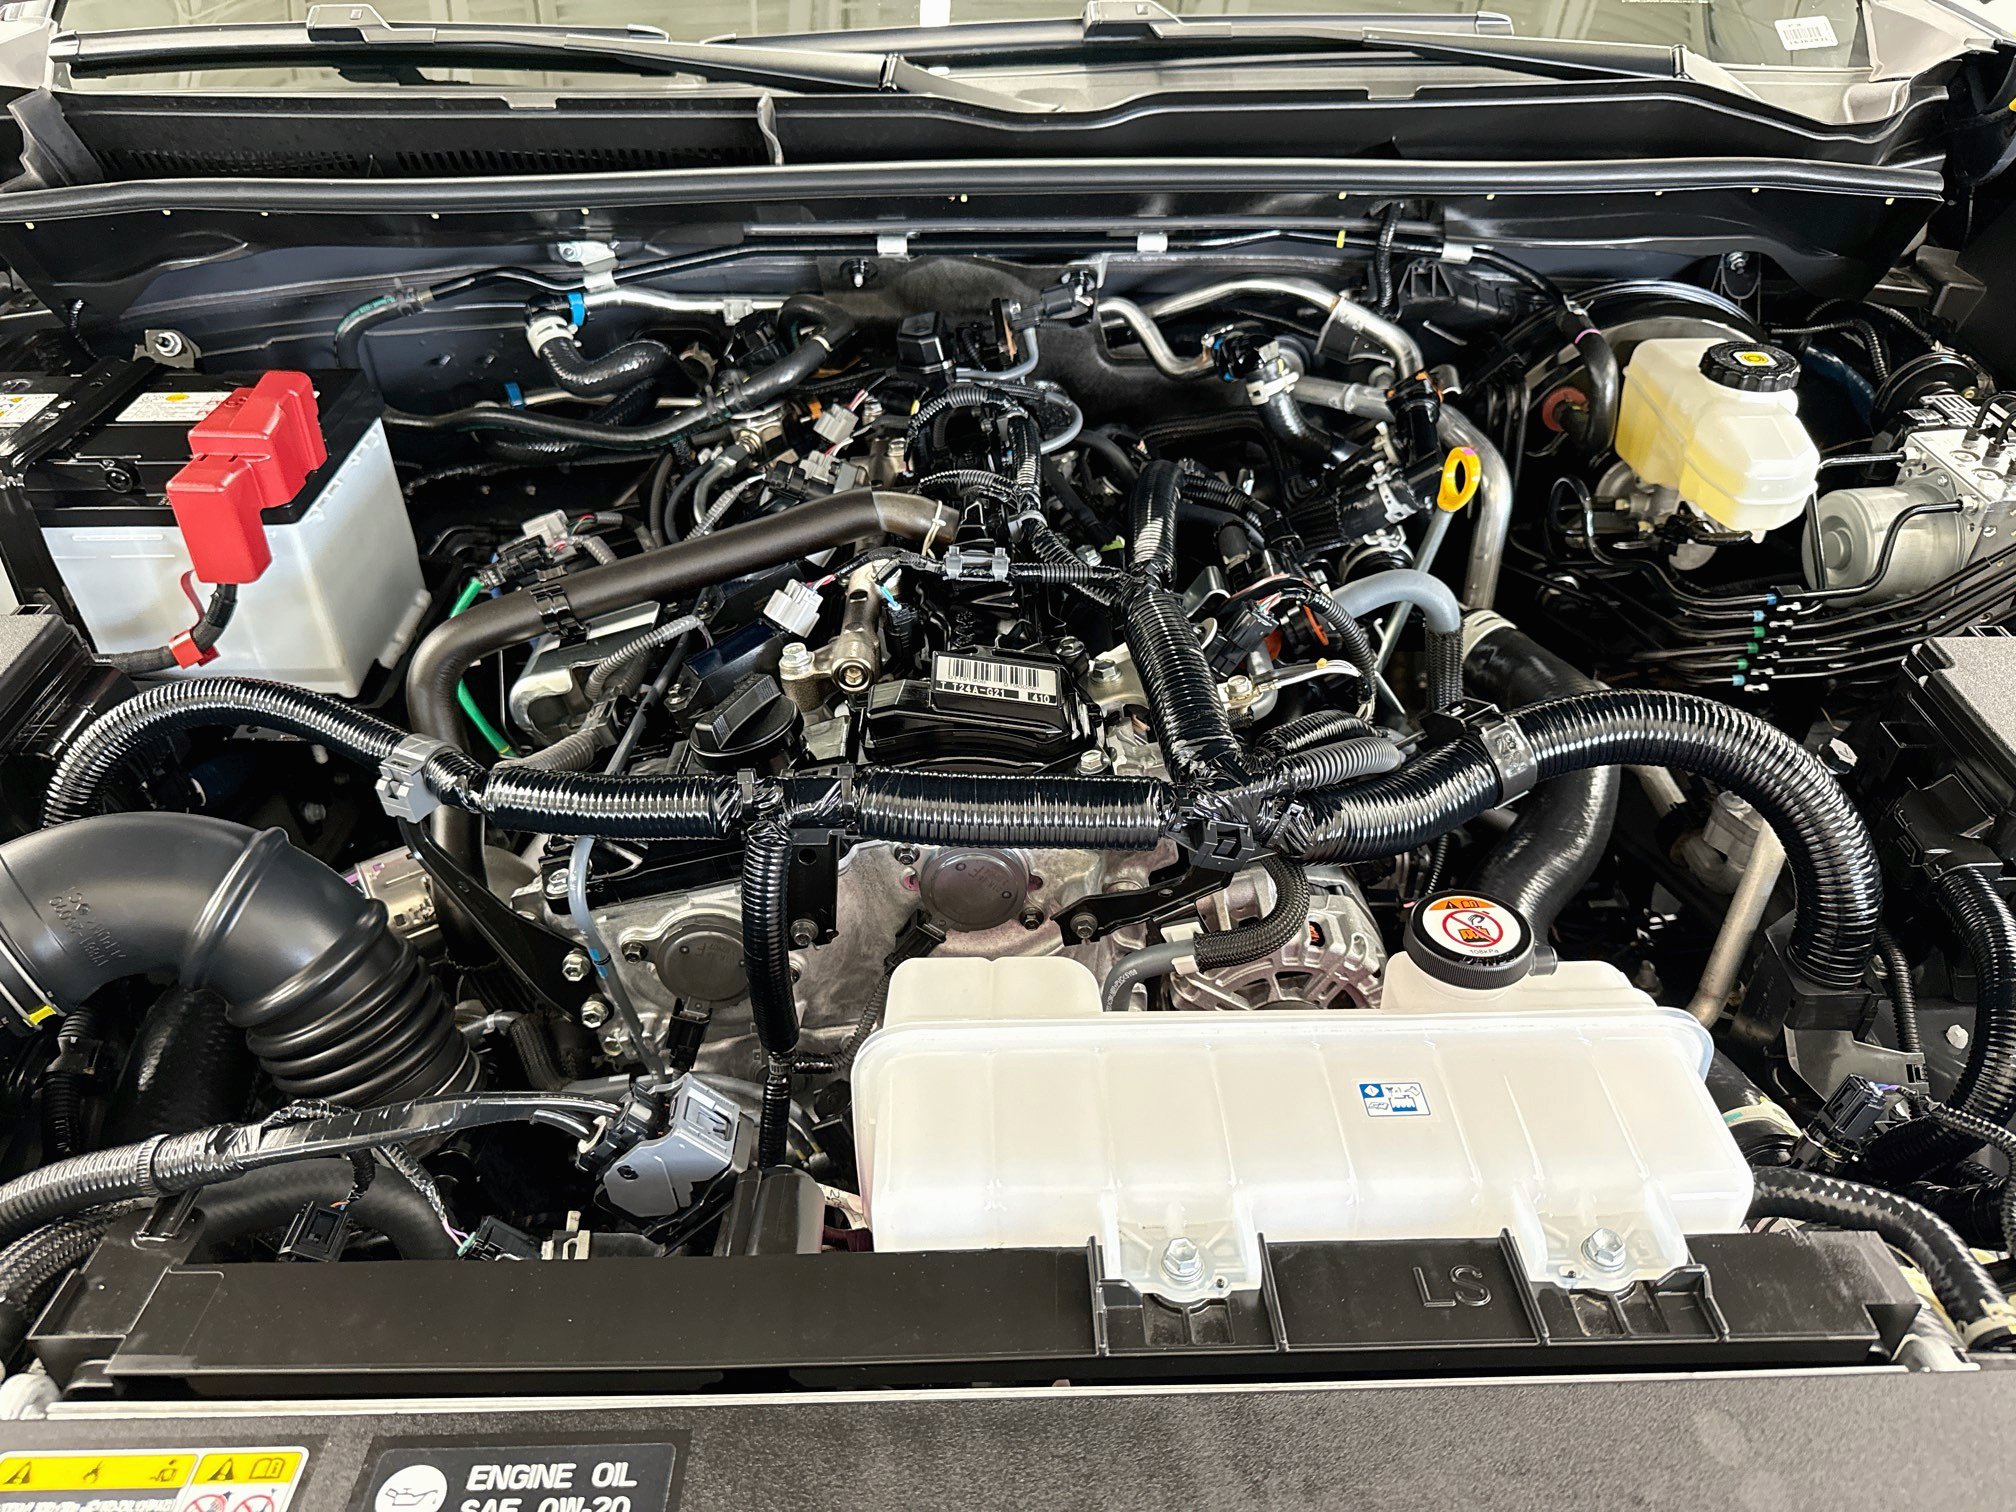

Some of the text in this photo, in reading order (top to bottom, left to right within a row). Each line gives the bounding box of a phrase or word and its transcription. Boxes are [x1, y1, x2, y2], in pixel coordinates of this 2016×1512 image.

[941, 681, 1051, 703] T T24A-G21 410
[1412, 1264, 1492, 1308] LS
[465, 1461, 638, 1491] ENGINE OIL
